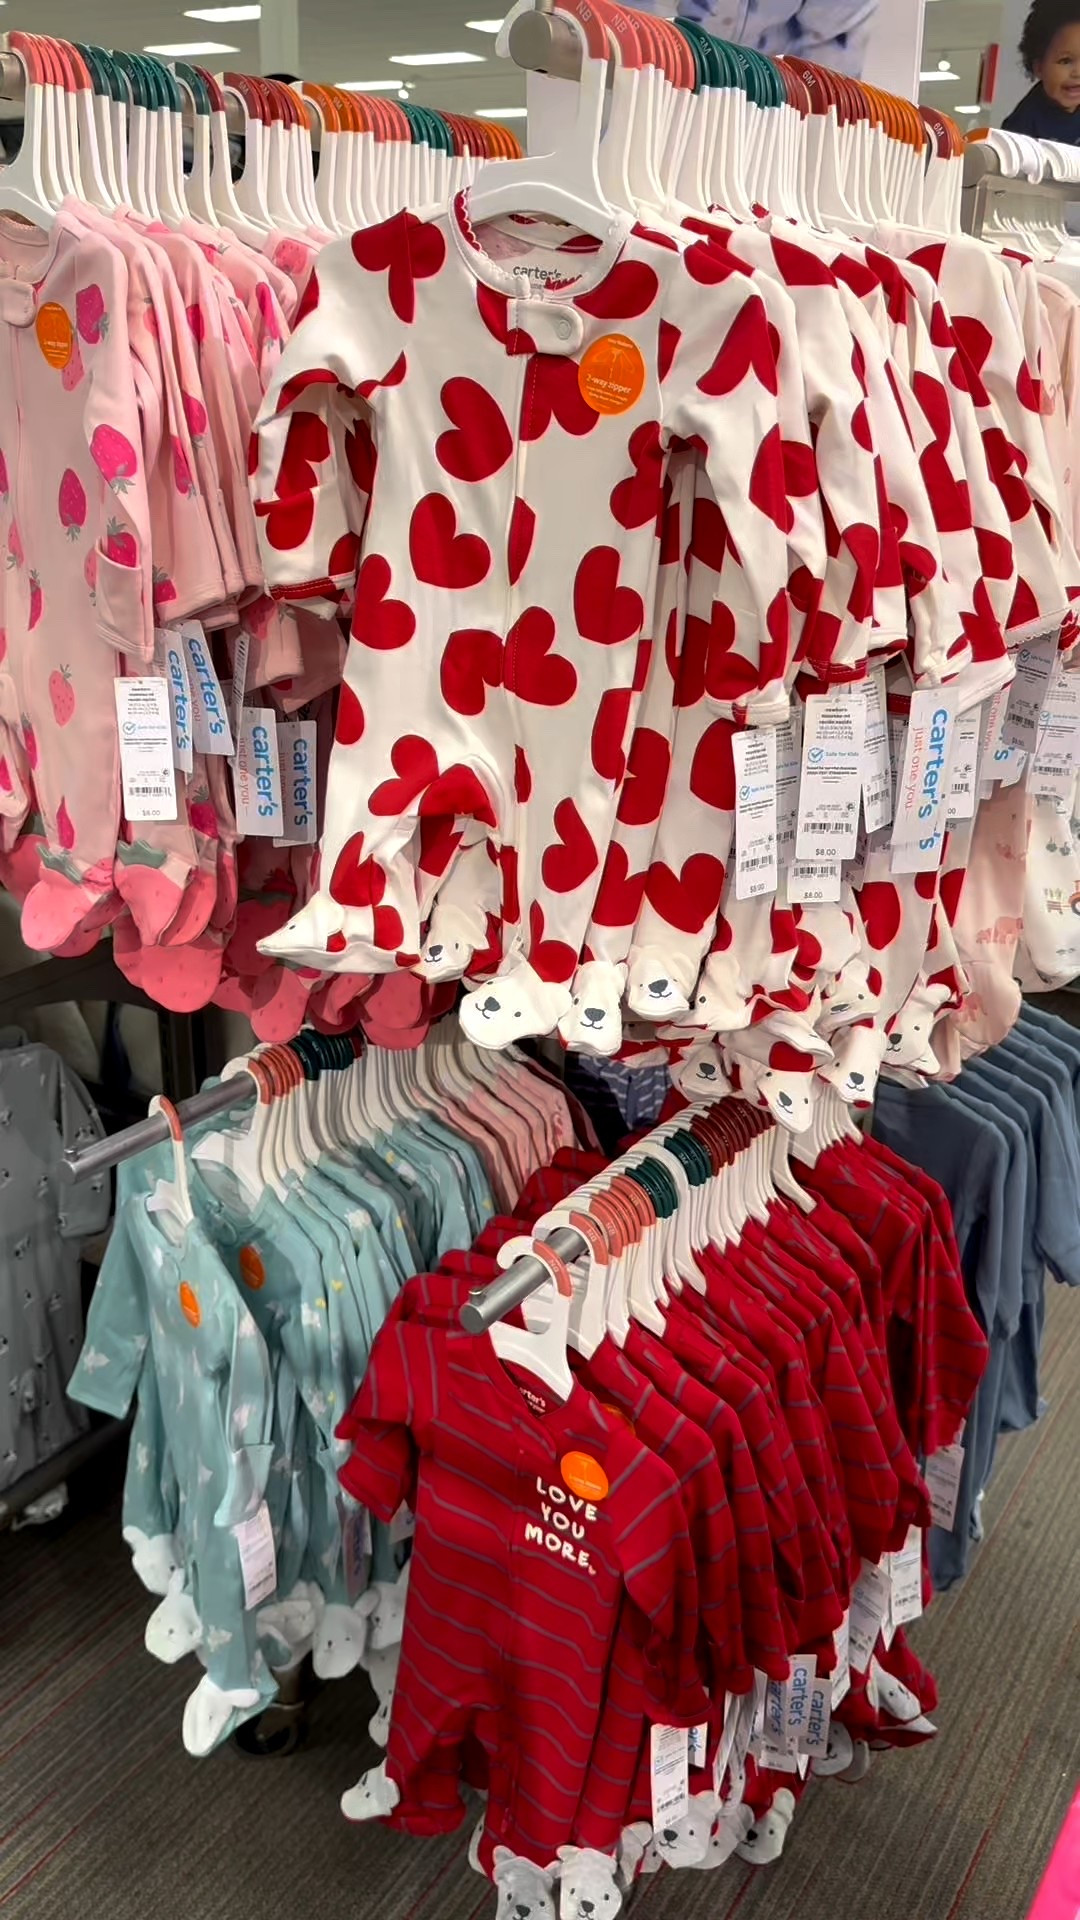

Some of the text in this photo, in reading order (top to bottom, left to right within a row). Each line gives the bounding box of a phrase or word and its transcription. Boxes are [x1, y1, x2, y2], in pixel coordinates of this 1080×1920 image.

[576, 1, 592, 22] NB
[611, 14, 627, 33] NB
[802, 70, 817, 87] 6M
[933, 122, 945, 137] 6M
[586, 373, 632, 394] 2-way zipper
[168, 649, 191, 750] carter's
[188, 638, 225, 735] carter's
[252, 726, 279, 817] carter's
[293, 738, 313, 826] carter's
[905, 727, 924, 810] just one you
[918, 708, 948, 820] carter's
[240, 782, 249, 805] you
[815, 848, 837, 856] $8.00
[536, 1475, 598, 1522] LOVE
[541, 1501, 586, 1539] YOU
[788, 1667, 808, 1726] carter's
[806, 1690, 825, 1746] carter's
